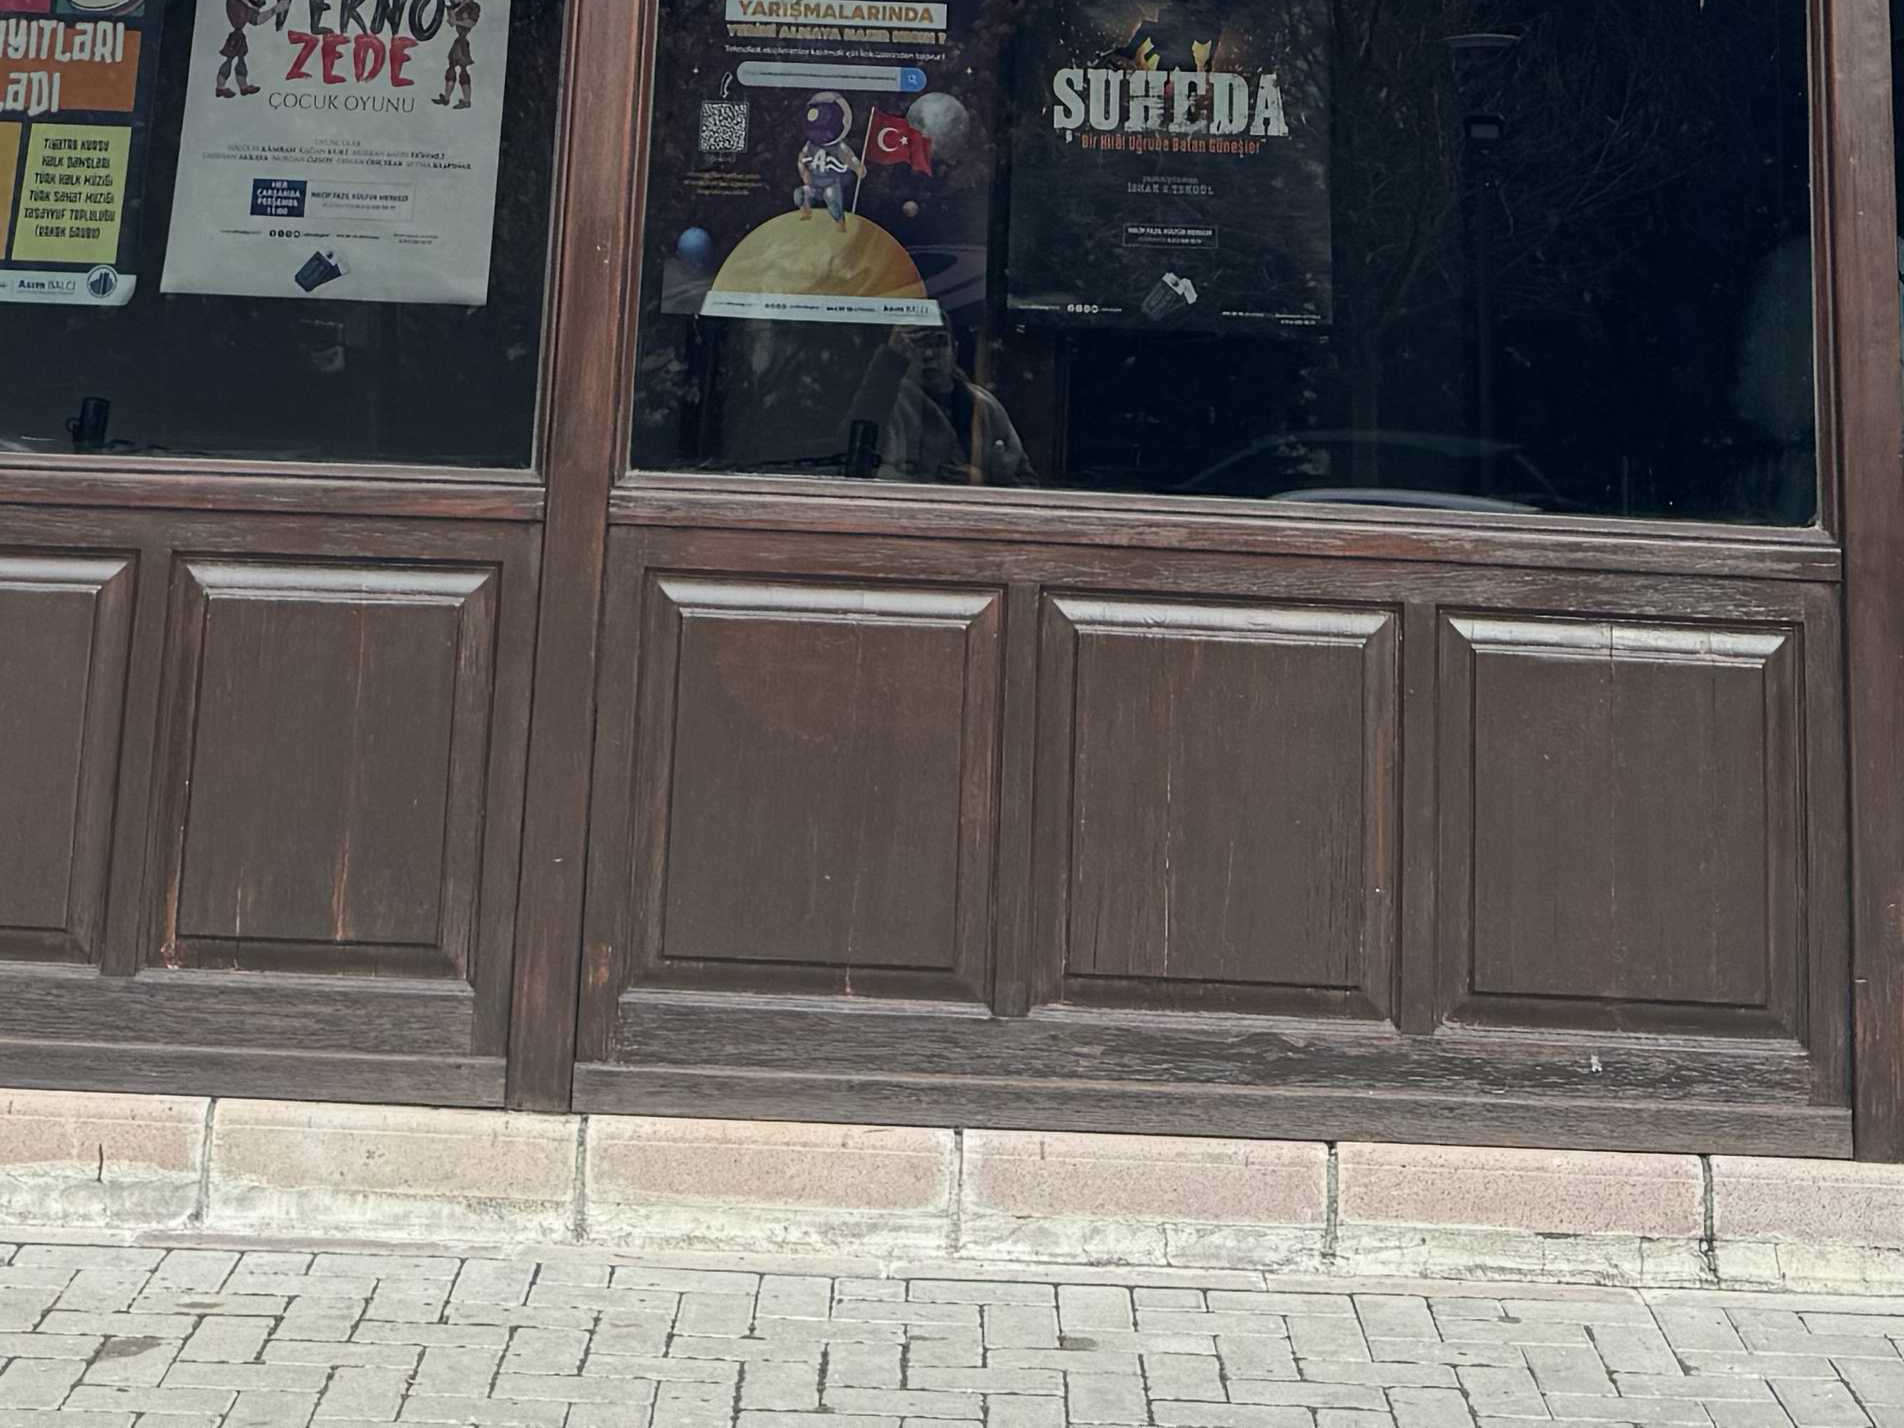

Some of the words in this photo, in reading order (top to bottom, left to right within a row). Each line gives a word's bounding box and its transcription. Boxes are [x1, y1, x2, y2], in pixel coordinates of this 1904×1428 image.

[739, 0, 935, 24] YARIŞMALARINDA
[286, 30, 418, 87] ZEDE
[268, 92, 338, 110] ÇOCUK
[344, 95, 415, 113] OYUNU
